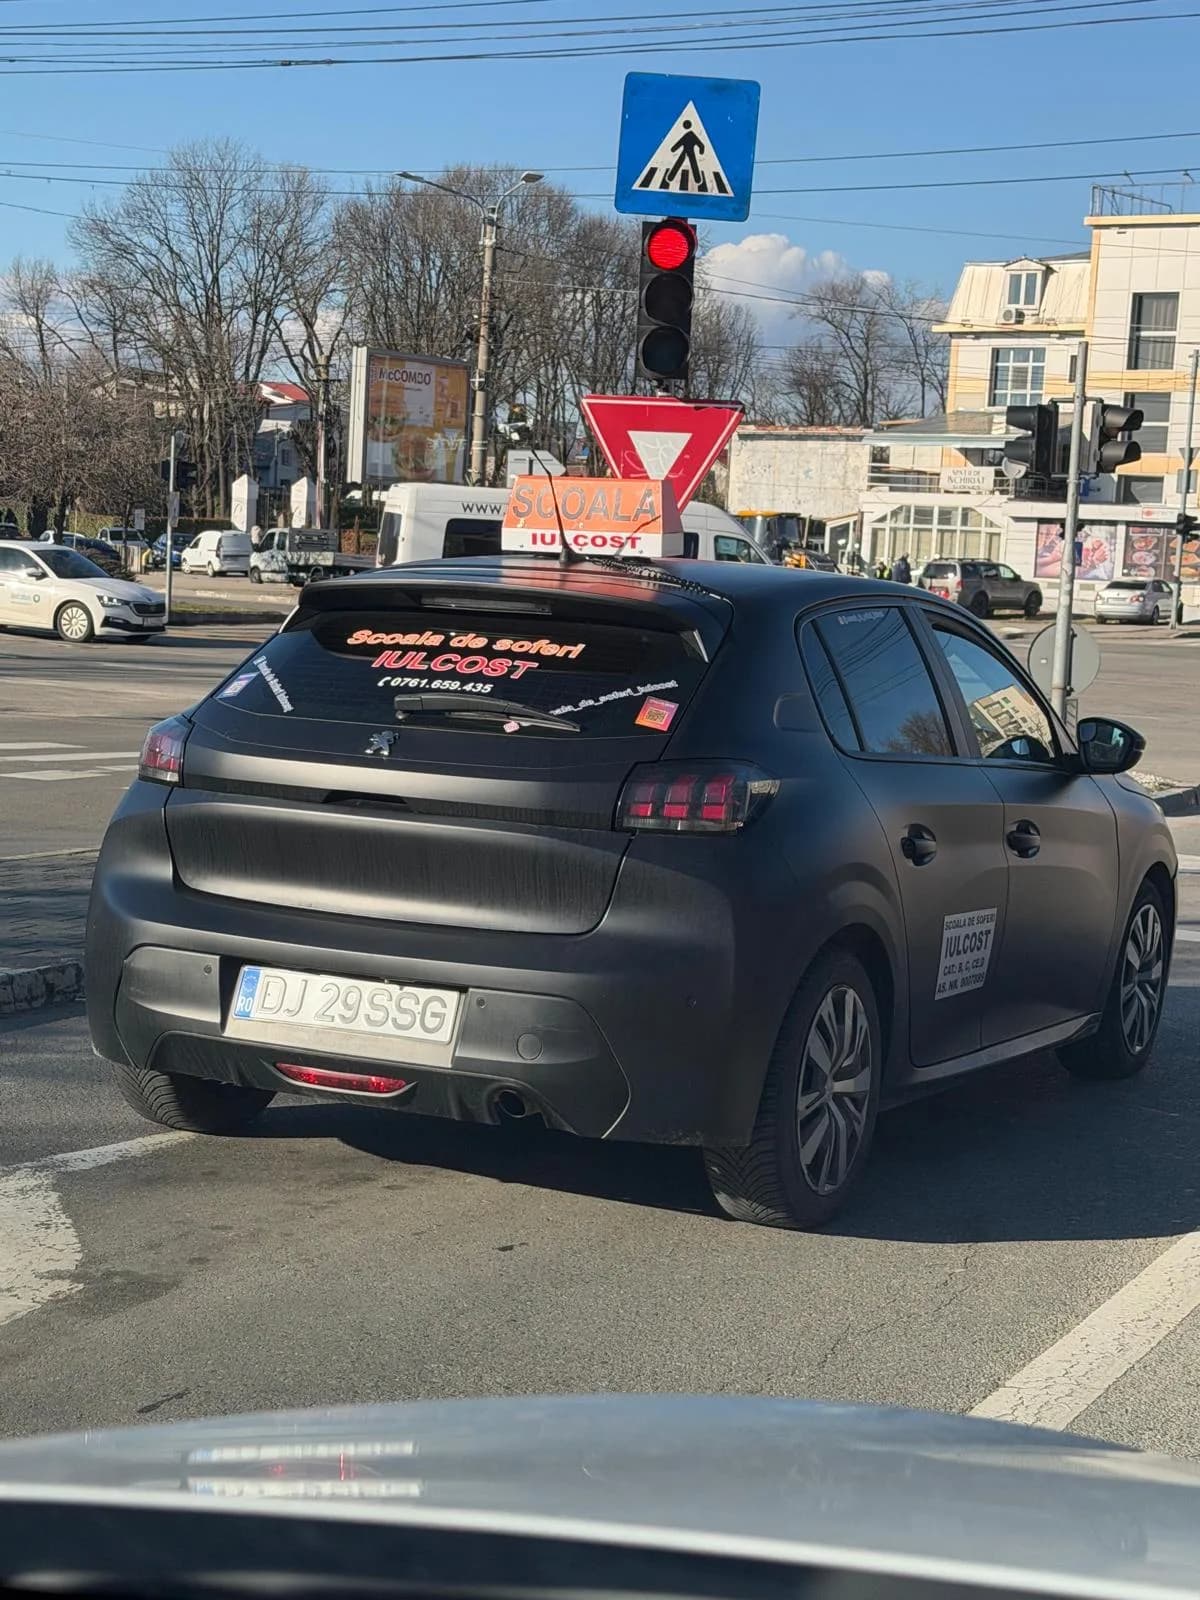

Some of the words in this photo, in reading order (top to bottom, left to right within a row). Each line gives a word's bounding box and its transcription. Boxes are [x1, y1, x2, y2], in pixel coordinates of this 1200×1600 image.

[346, 629, 445, 648] Scoala
[449, 632, 488, 649] de
[371, 650, 539, 680] IULCOST
[390, 676, 494, 694] 0761.659.435
[968, 917, 975, 926] DE
[945, 930, 991, 959] IULCOST
[236, 995, 253, 1013] RO
[256, 975, 309, 1018] DJ
[313, 982, 448, 1035] 29SSG
